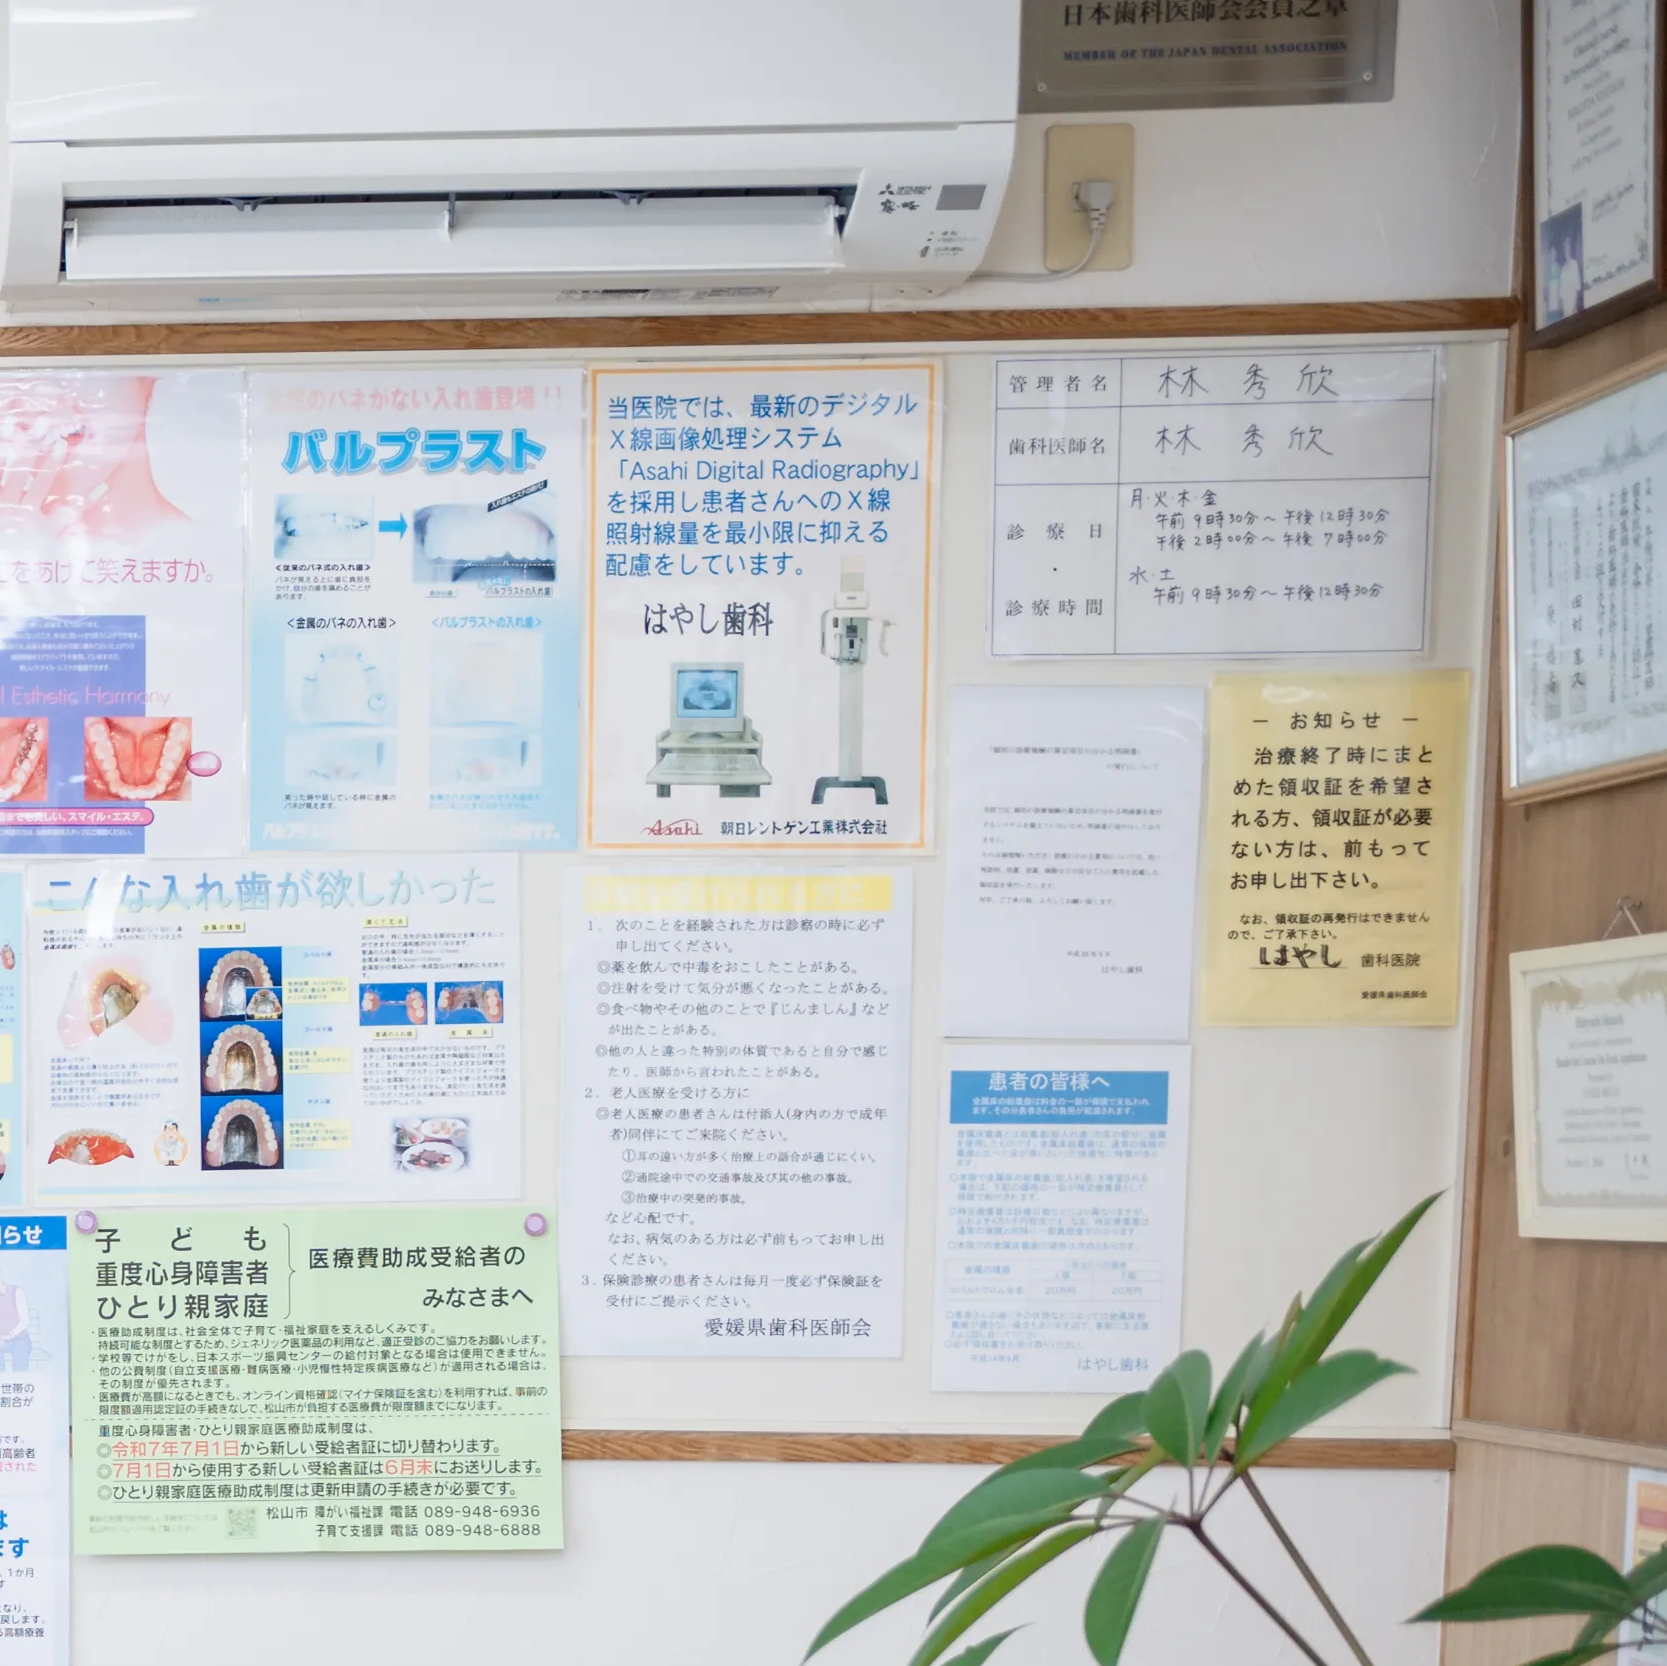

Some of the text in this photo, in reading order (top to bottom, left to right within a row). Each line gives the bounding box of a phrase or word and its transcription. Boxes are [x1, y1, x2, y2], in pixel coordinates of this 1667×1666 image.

[1064, 51, 1115, 61] MEMBER
[1142, 48, 1164, 59] THE
[1168, 46, 1206, 58] JAPAN
[1212, 45, 1257, 56] DENTAL
[1264, 40, 1347, 54] ASSOCIATION
[1009, 374, 1108, 393] 管理者名
[608, 393, 918, 420] 当医院では、最新のデジタル
[610, 427, 843, 451] X線画像処理システム
[1008, 436, 1106, 456] 歯科医師名
[281, 427, 546, 475] バルプラスト
[619, 459, 920, 483] 「Asahi Digital Radiography」
[606, 488, 891, 514] を採用し患者さんへのX線
[606, 520, 890, 546] 照射線量を最小限に抑える
[1007, 522, 1103, 541] 診療日
[605, 552, 806, 578] 配慮をしています。
[1005, 598, 1103, 617] 診療時間
[644, 602, 774, 637] はやし歯科
[11, 685, 76, 706] Esthetic
[86, 685, 171, 708] Harmony
[1254, 745, 1434, 765] 治療終了時にまと
[1233, 775, 1434, 796] めた領収証を希望さ
[1231, 807, 1433, 828] れる方、領収証が必要
[641, 818, 703, 837] Asahi
[720, 820, 888, 836] 朝日レントゲン工業株式会社
[1231, 839, 1431, 858] ない方は、前もって
[1231, 870, 1380, 890] お申し出下さい。
[615, 918, 885, 933] 次のことを経験された方は診察の時に必ず
[1239, 910, 1430, 925] なお、領収証の再発行はできません
[1227, 927, 1338, 941] ので、ご了承下さい。
[615, 939, 736, 954] 申し出てください。
[1258, 943, 1421, 969] はやし 歯科医院
[1361, 989, 1427, 1000] 愛媛県歯科医師会
[608, 1023, 718, 1037] が出たことがある。
[607, 1066, 823, 1079] たり、医師から言われたことがある。
[988, 1071, 1110, 1092] 患者の皆様へ
[610, 1086, 750, 1100] 老人医療を受ける方に
[609, 1127, 792, 1142] 者)同伴にてご来院ください。
[622, 1190, 749, 1205] ③治療中の突発的事故。
[605, 1211, 699, 1226] など心配です。
[95, 1226, 267, 1253] 子ども
[608, 1231, 885, 1247] なお、病気のある方は必ず前もってお申し出
[309, 1245, 526, 1269] 医療費助成受給者の
[608, 1253, 671, 1267] ください。
[96, 1261, 269, 1287] 重度心身障害者
[602, 1273, 883, 1288] 保険診療の患者さんは毎月一度必ず保険証を
[97, 1293, 269, 1320] ひとり親家庭
[422, 1287, 534, 1309] みなさまへ
[606, 1294, 755, 1309] 受付にご提示ください。
[705, 1317, 872, 1338] 愛媛県歯科医師会
[1077, 1357, 1149, 1372] はやし歯科
[99, 1378, 231, 1390] その制度が優先されます。
[99, 1422, 374, 1438] 重度心身障害者・ひとり親家庭医療助成制度は、
[266, 1504, 541, 1520] 松山市 障がい福祉課 電話 089-948-6936
[315, 1523, 541, 1538] 子育て支援課 電話 089-948-6888
